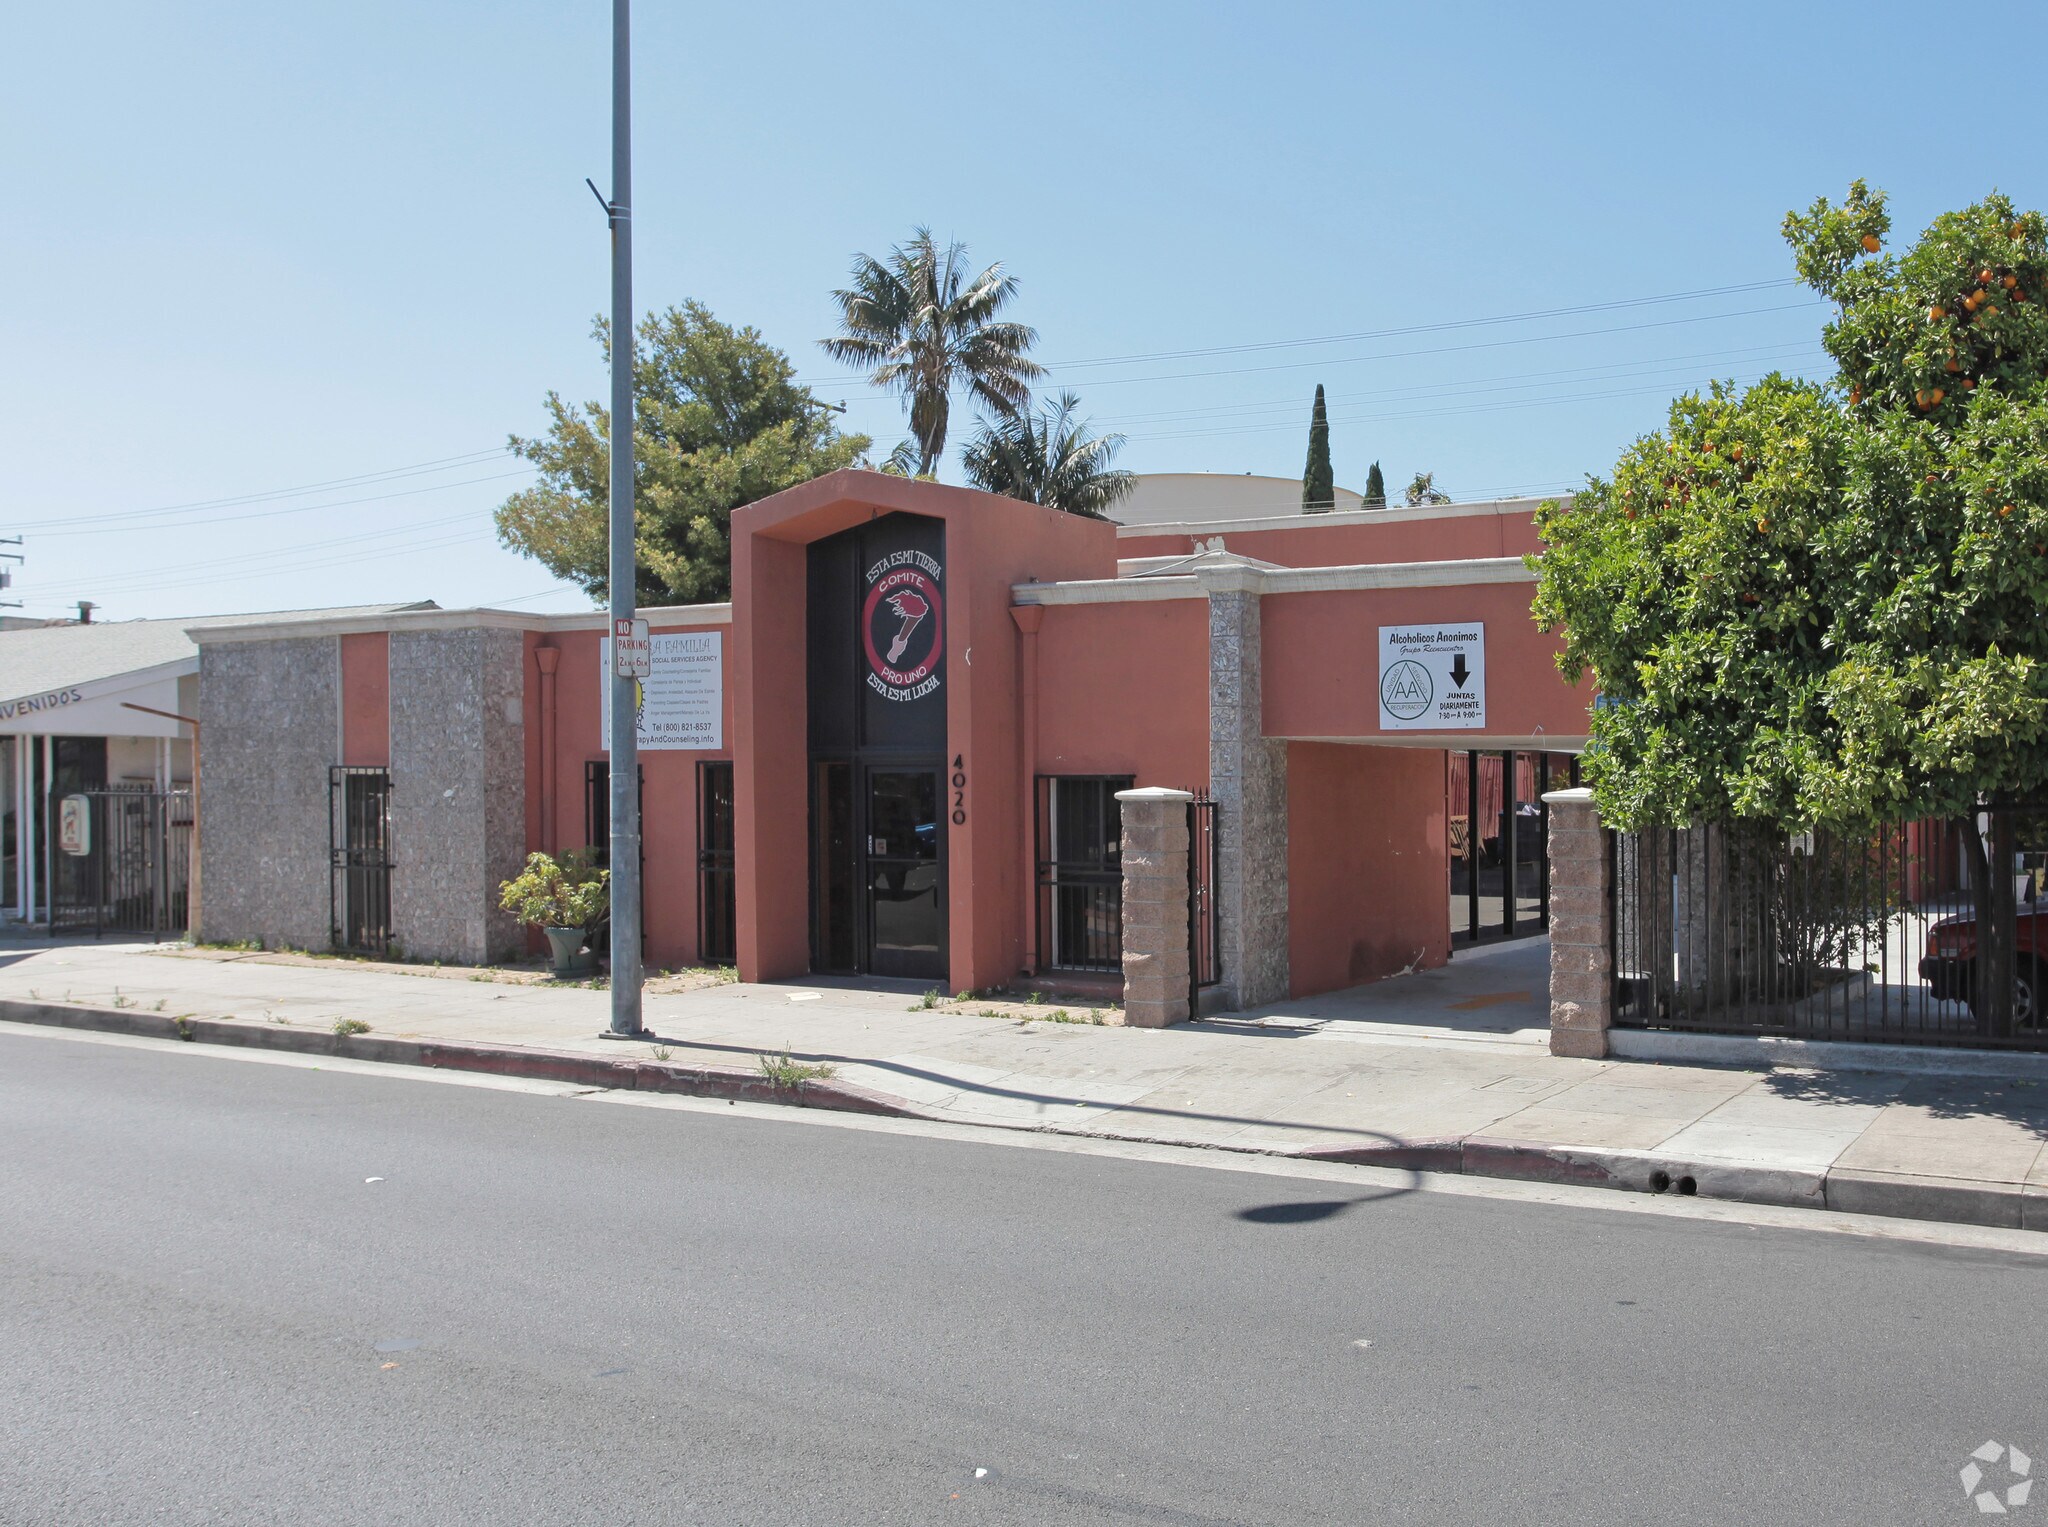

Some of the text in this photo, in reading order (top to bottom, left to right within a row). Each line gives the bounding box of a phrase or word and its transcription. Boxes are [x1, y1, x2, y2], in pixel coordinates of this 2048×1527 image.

[866, 558, 889, 584] ESTA
[915, 550, 942, 581] TIERRA
[879, 572, 925, 593] COMITE
[617, 621, 630, 635] NO
[618, 640, 648, 651] PARKING
[665, 638, 711, 653] FAMILIA
[1389, 631, 1478, 645] Alcoholicos Anonimos
[1399, 644, 1464, 656] Grupo Reencuentro
[881, 666, 927, 685] PRO UNO
[1385, 668, 1400, 693] UNIDAD
[1411, 666, 1428, 694] SERVICIO
[866, 672, 887, 697] ESTA
[911, 674, 941, 700] LUCHA
[1394, 681, 1419, 699] AA
[1446, 692, 1476, 700] JUNTAS
[1439, 701, 1480, 710] DIARIAMENTE
[652, 722, 711, 732] Tel (800) 821-8537
[952, 753, 966, 825] 4020
